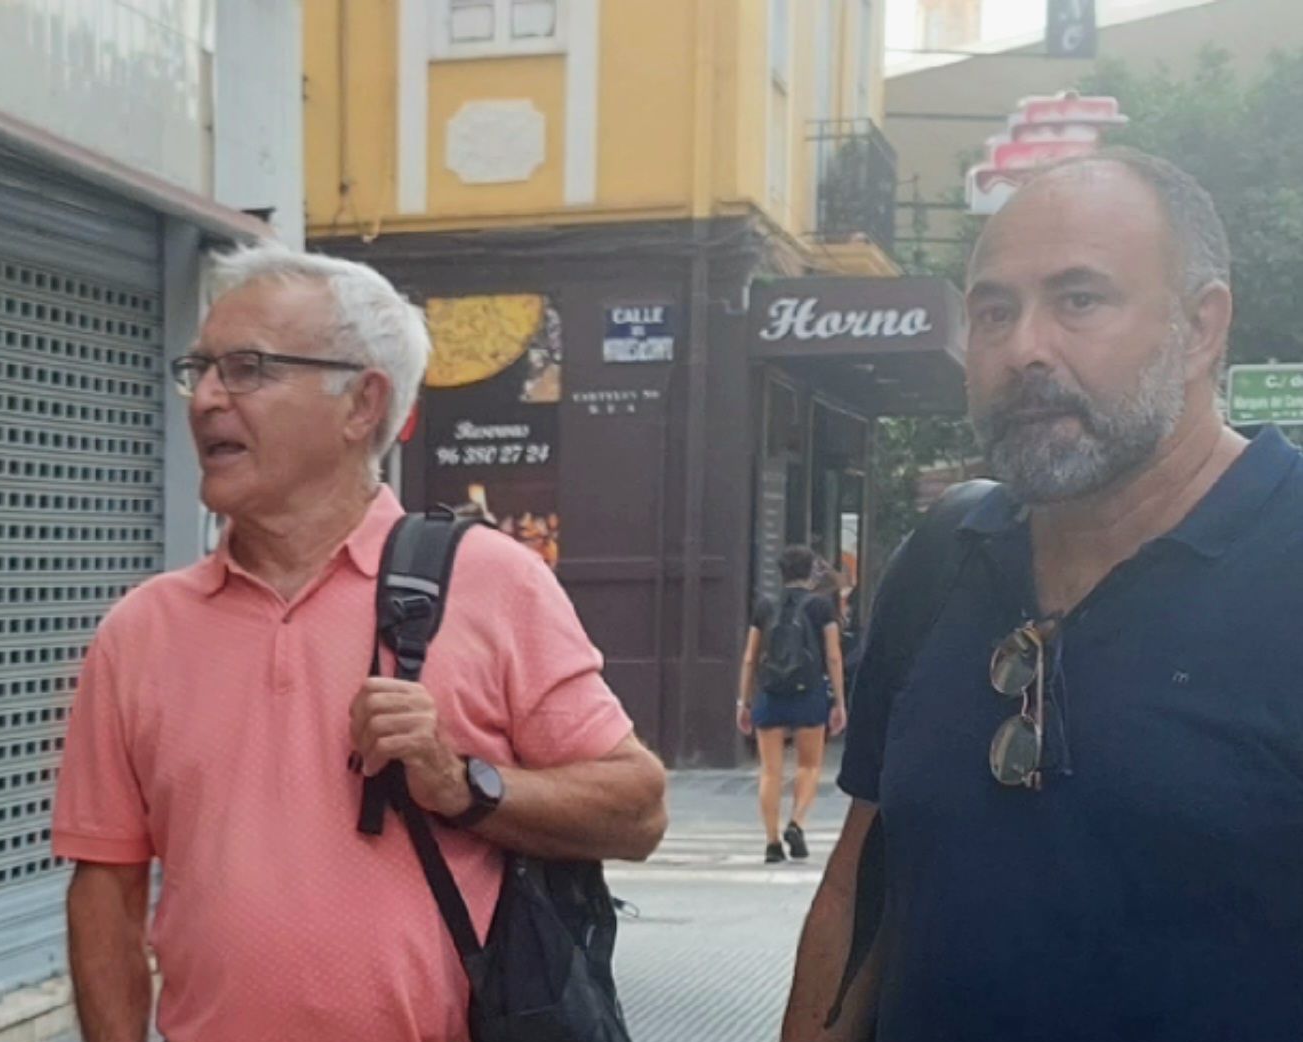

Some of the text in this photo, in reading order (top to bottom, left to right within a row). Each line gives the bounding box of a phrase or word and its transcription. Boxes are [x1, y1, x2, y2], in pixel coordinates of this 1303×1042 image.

[611, 307, 665, 324] CALLE
[759, 297, 932, 341] Horno
[499, 444, 523, 464] 27
